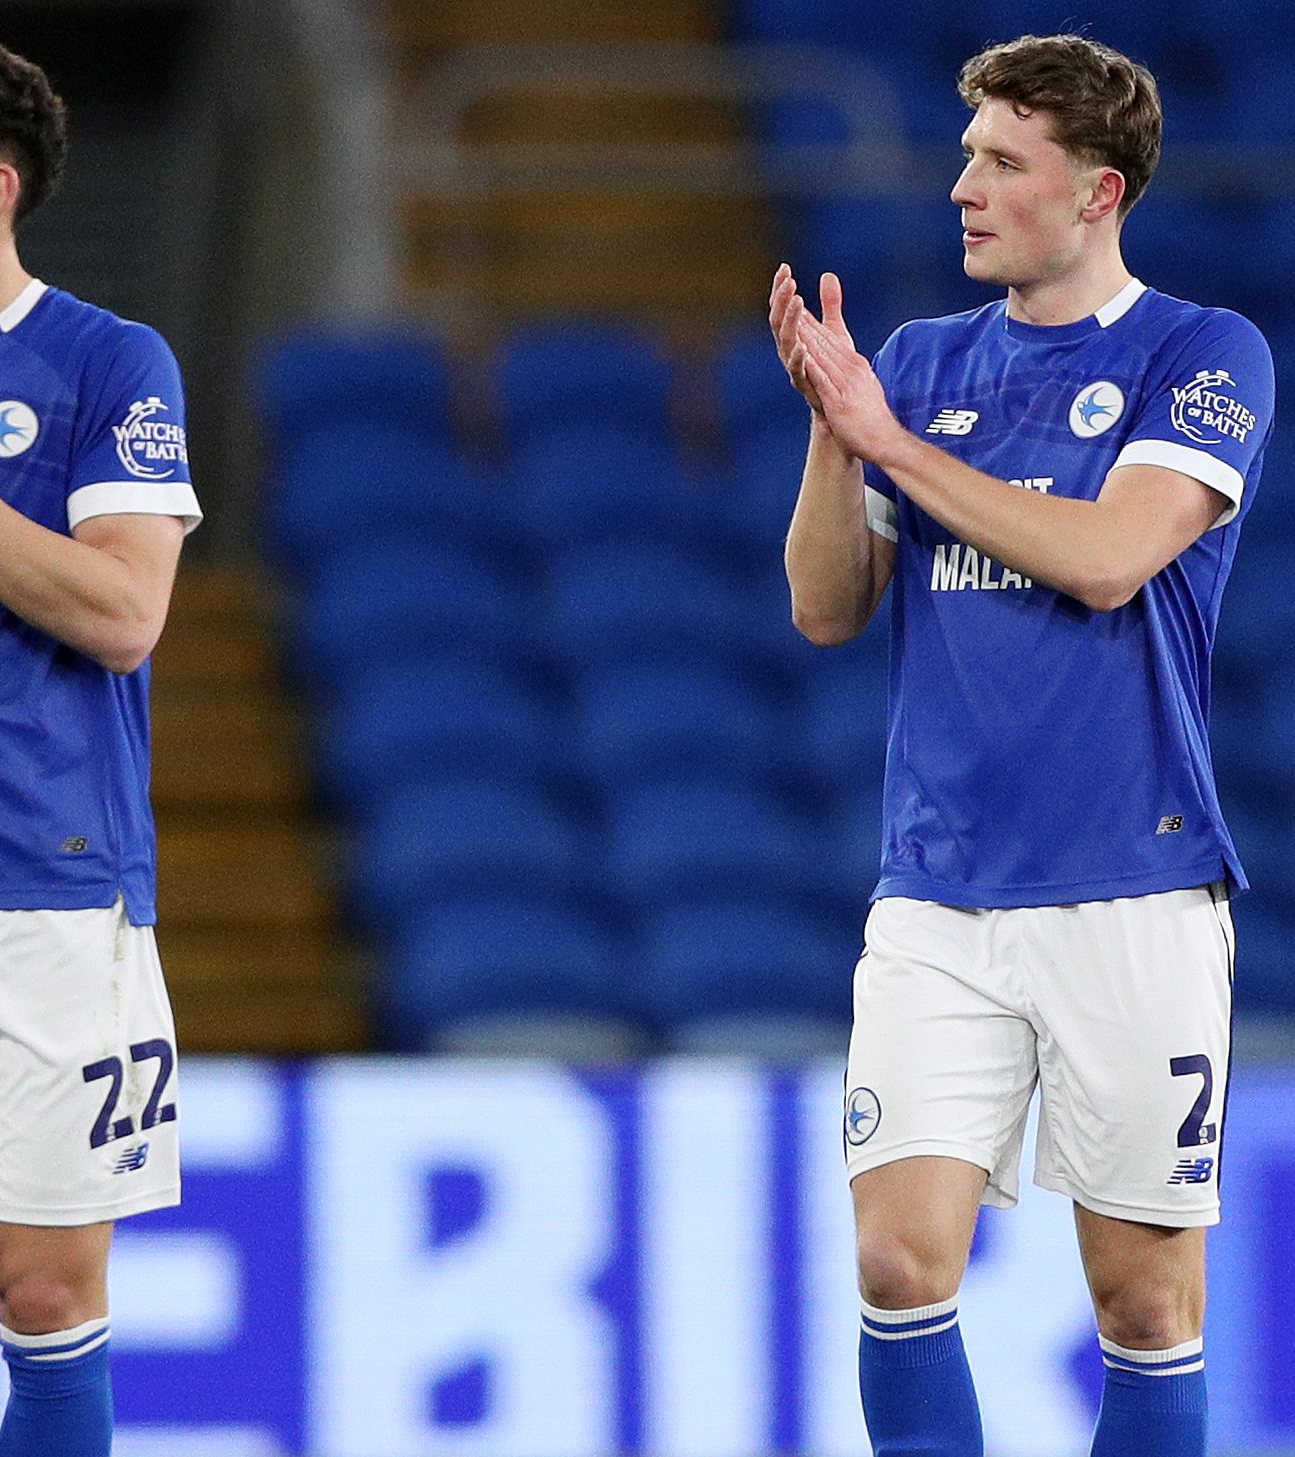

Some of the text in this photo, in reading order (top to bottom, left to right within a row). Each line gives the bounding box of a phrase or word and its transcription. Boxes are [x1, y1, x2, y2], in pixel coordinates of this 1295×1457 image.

[1171, 387, 1256, 430] WATCHES
[1201, 410, 1247, 443] BATH
[930, 544, 1033, 591] MALA
[82, 1038, 177, 1149] 22
[1169, 1053, 1217, 1148] 2
